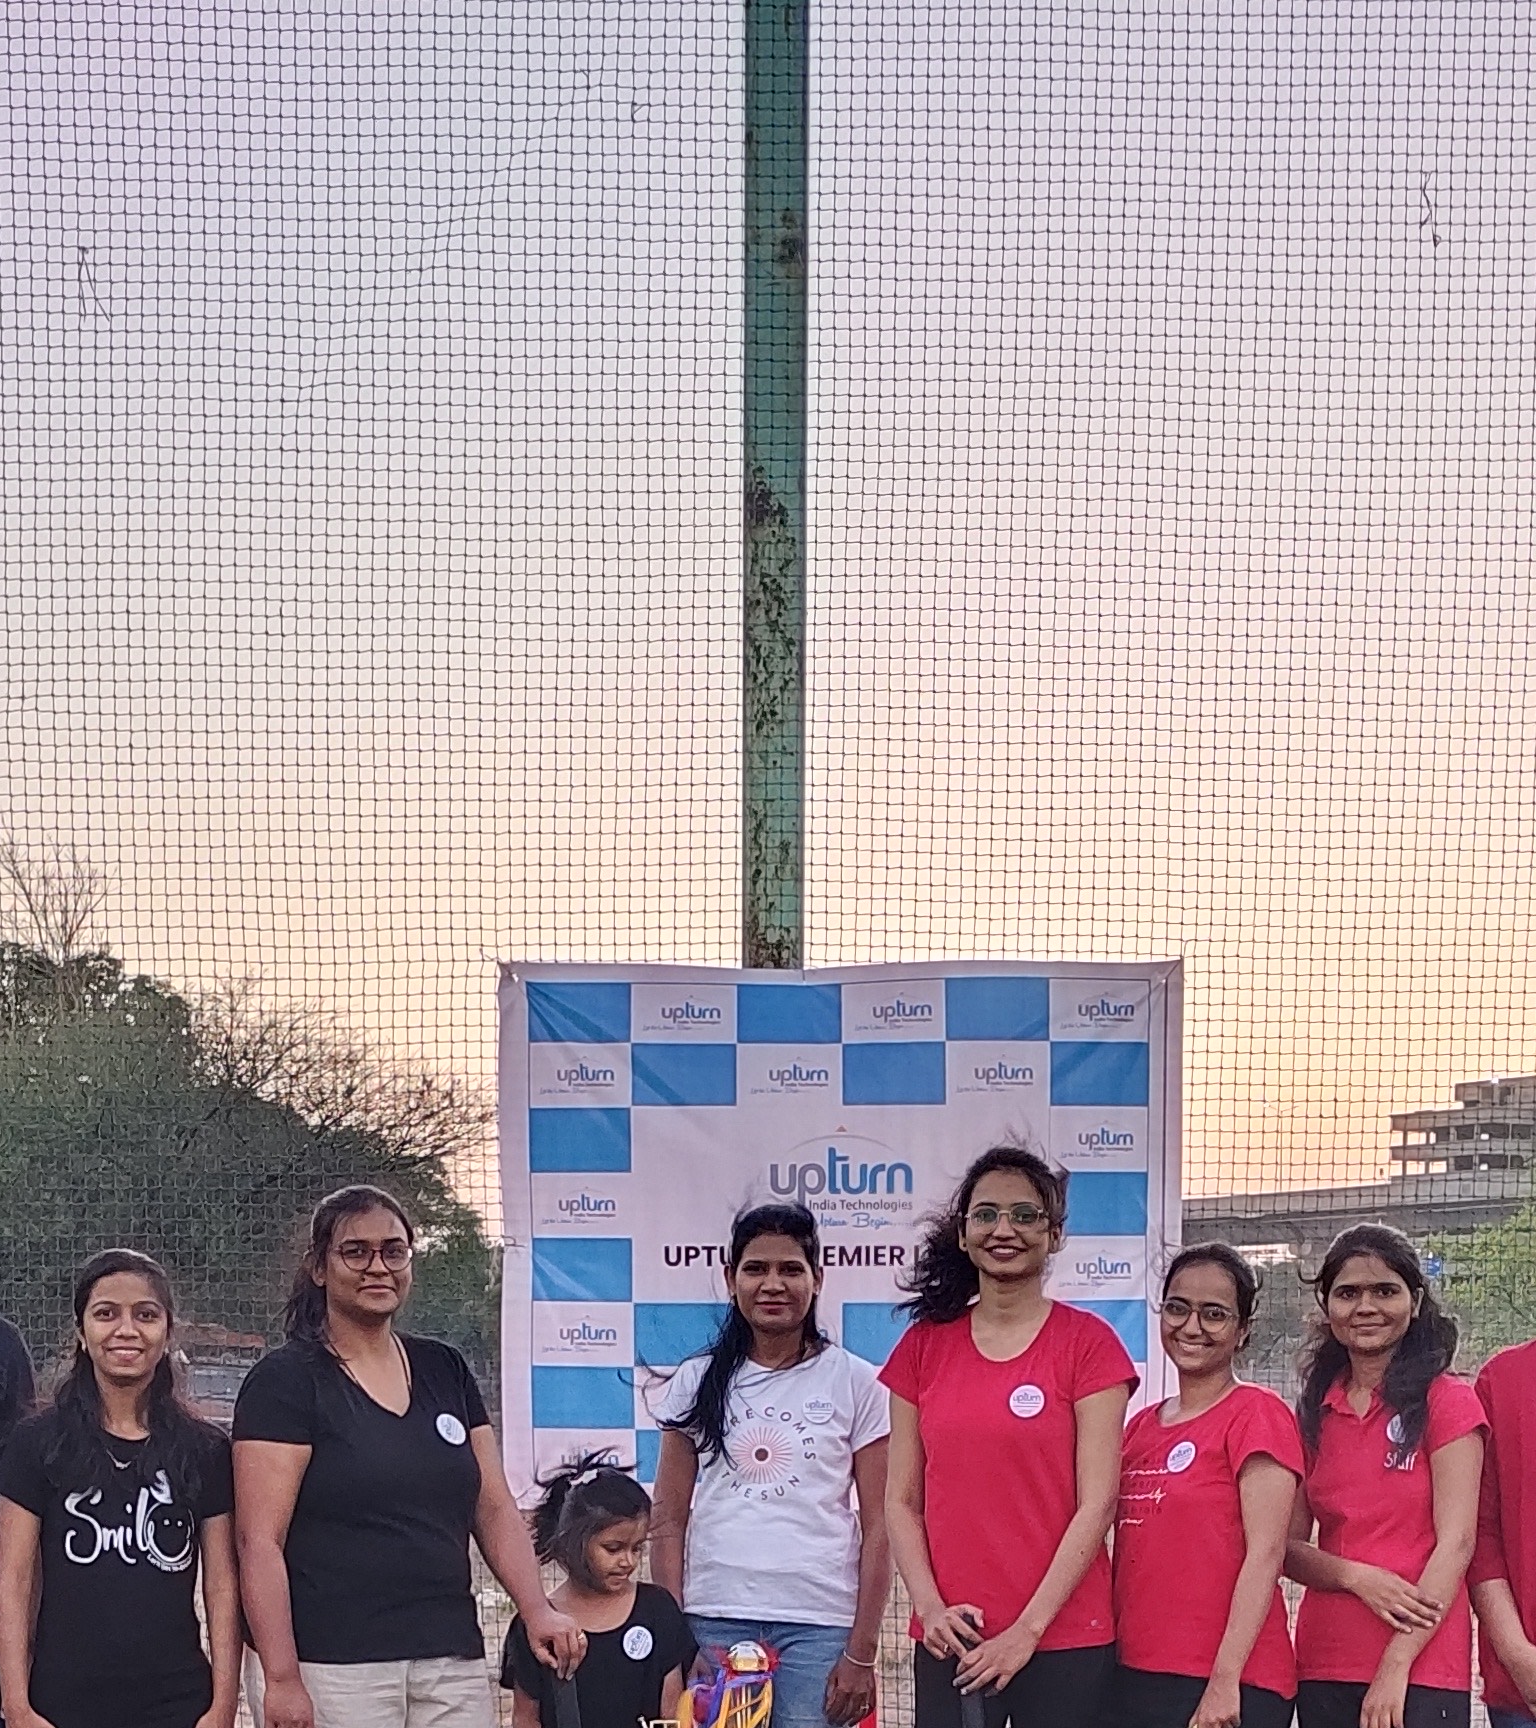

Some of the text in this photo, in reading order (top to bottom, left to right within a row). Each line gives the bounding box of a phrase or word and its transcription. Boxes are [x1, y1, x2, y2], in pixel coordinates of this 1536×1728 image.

[661, 1001, 721, 1024] upturn
[871, 1000, 932, 1023] upturn
[1077, 999, 1134, 1023] upturn
[556, 1063, 614, 1085] upturn
[768, 1063, 829, 1087] upturn
[974, 1061, 1033, 1085] upturn
[1078, 1127, 1134, 1150] upturn
[769, 1146, 913, 1203] upturn
[558, 1193, 616, 1216] upturn
[809, 1199, 913, 1213] India Technologies
[664, 1245, 729, 1267] UPT
[821, 1245, 906, 1267] EMIER
[1075, 1256, 1132, 1279] upturn
[559, 1322, 616, 1345] upturn
[760, 1475, 801, 1501] SUN
[64, 1485, 191, 1564] Smile
